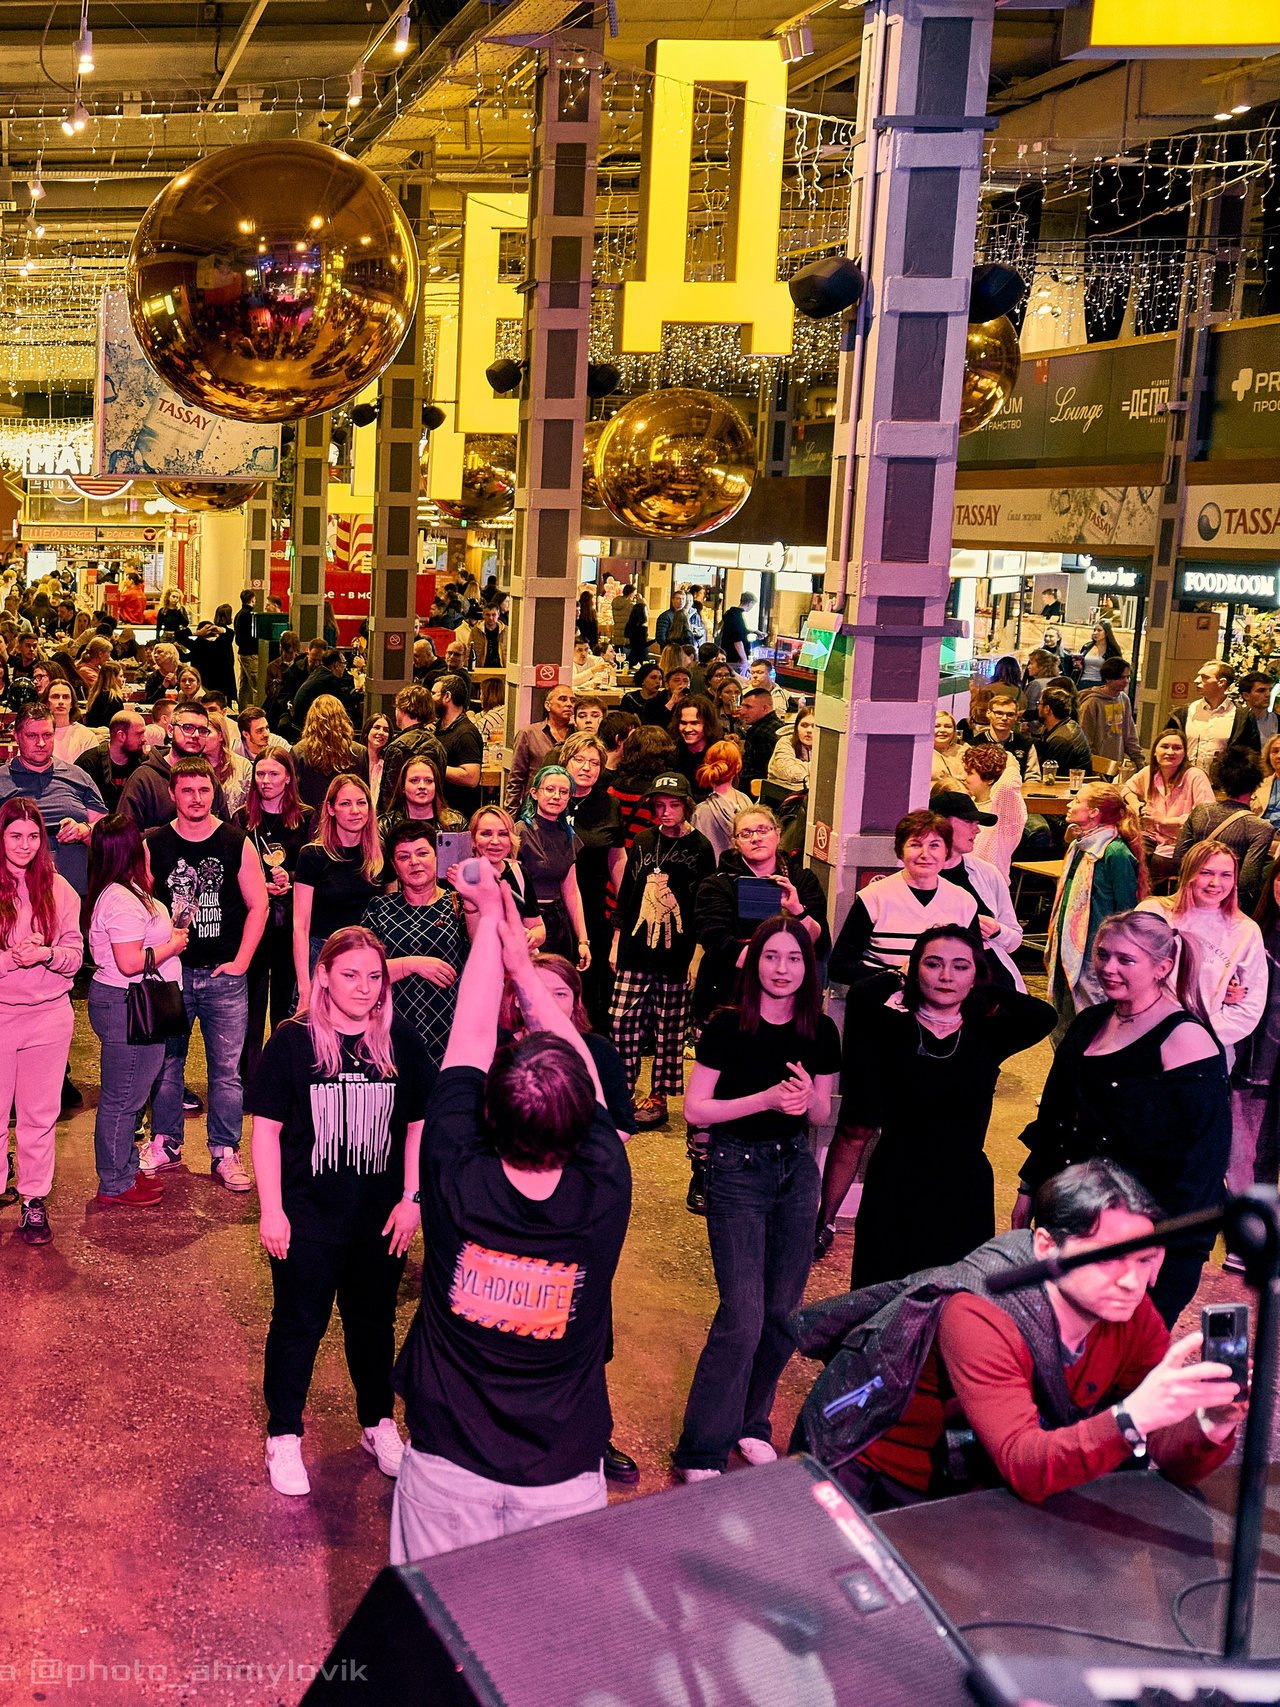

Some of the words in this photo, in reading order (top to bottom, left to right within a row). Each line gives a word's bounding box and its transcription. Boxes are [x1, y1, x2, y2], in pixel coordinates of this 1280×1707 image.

[158, 397, 212, 431] TASSAY
[1050, 386, 1104, 434] Lounge
[956, 504, 1001, 526] TASSAY
[1088, 508, 1114, 536] TASSAY
[62, 530, 95, 538] BURGER
[1184, 571, 1276, 597] FOODROOM
[655, 776, 678, 788] BTS
[310, 1083, 342, 1092] EACH
[345, 1083, 396, 1092] MOMENT
[338, 1073, 369, 1082] FEEL
[458, 1267, 571, 1310] VLADISLIFE
